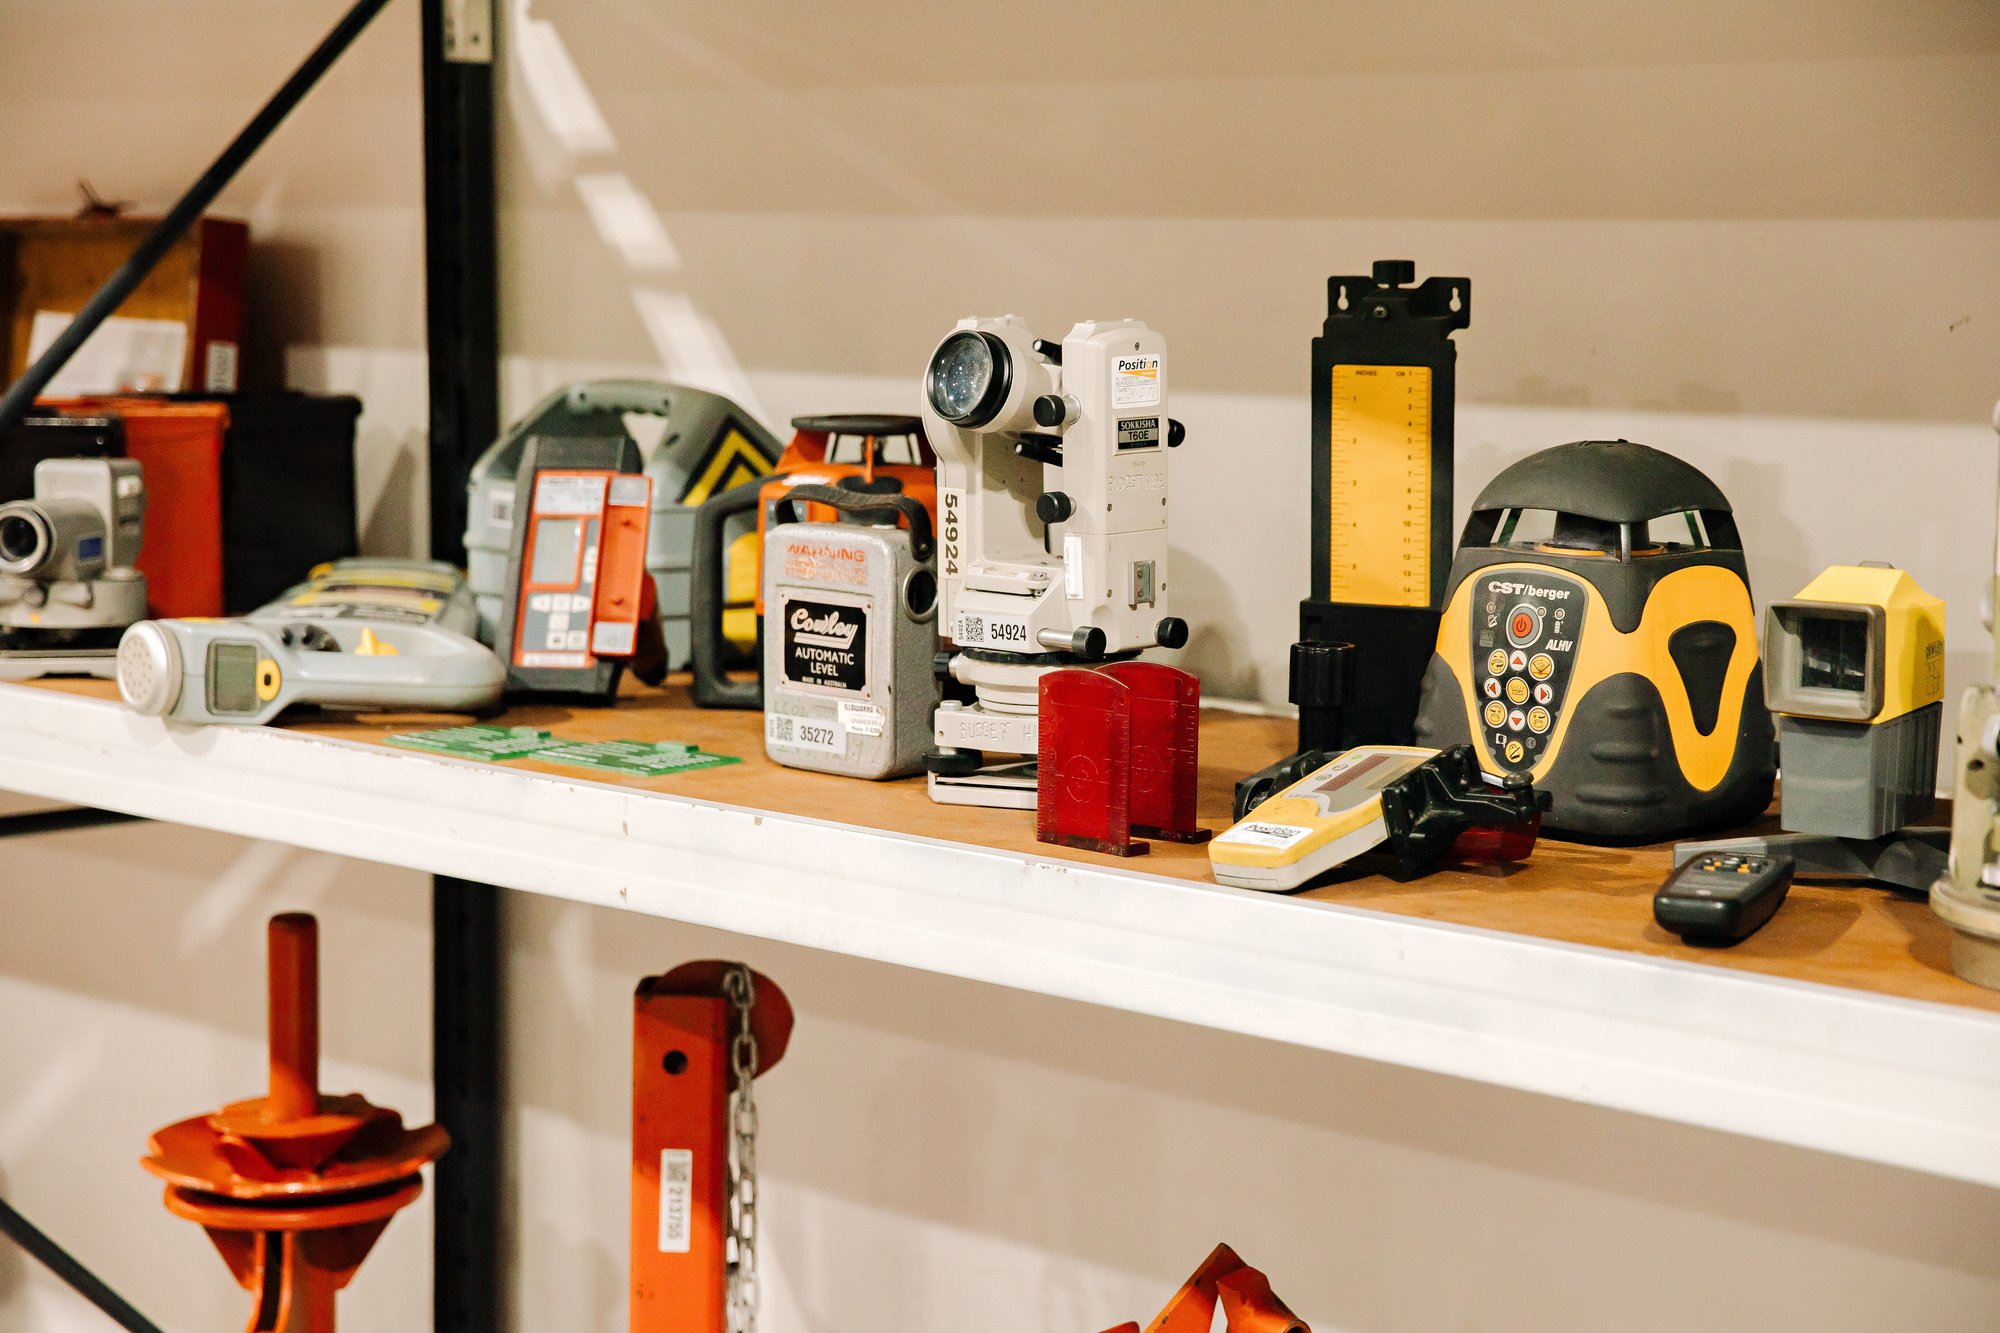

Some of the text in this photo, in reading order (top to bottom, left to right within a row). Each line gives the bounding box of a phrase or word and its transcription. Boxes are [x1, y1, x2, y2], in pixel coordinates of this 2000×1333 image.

[1118, 358, 1158, 371] Position
[1120, 419, 1156, 430] SOKKISHA
[1128, 430, 1149, 441] T60E
[944, 493, 959, 576] 54924
[1488, 581, 1570, 600] CST/berger
[991, 623, 1027, 641] 54924
[1545, 639, 1573, 652] ALHV
[795, 646, 855, 665] AUTOMATIC
[810, 661, 839, 677] LEVEL
[800, 725, 835, 746] 35272
